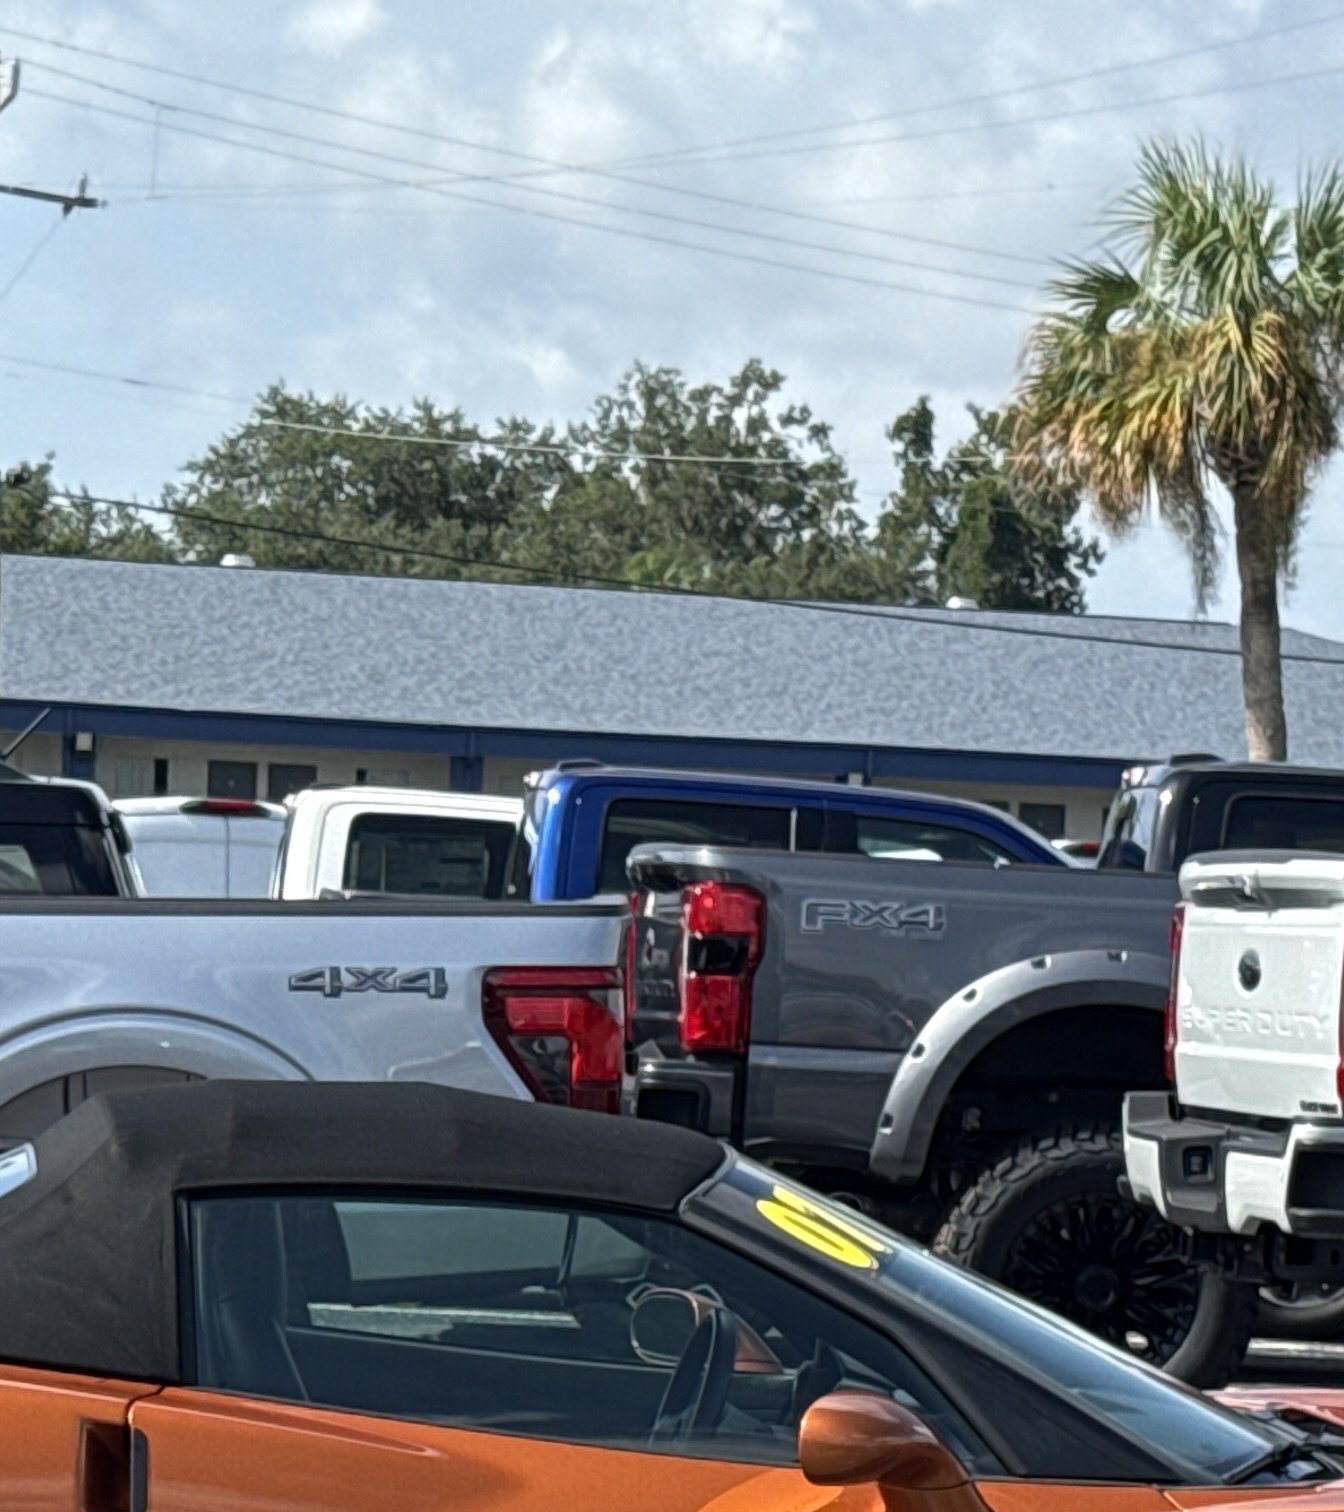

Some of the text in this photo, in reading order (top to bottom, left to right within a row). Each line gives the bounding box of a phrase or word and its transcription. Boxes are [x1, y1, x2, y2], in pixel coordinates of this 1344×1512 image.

[800, 899, 946, 934] FX4
[1181, 1003, 1330, 1041] SUPER DUTY
